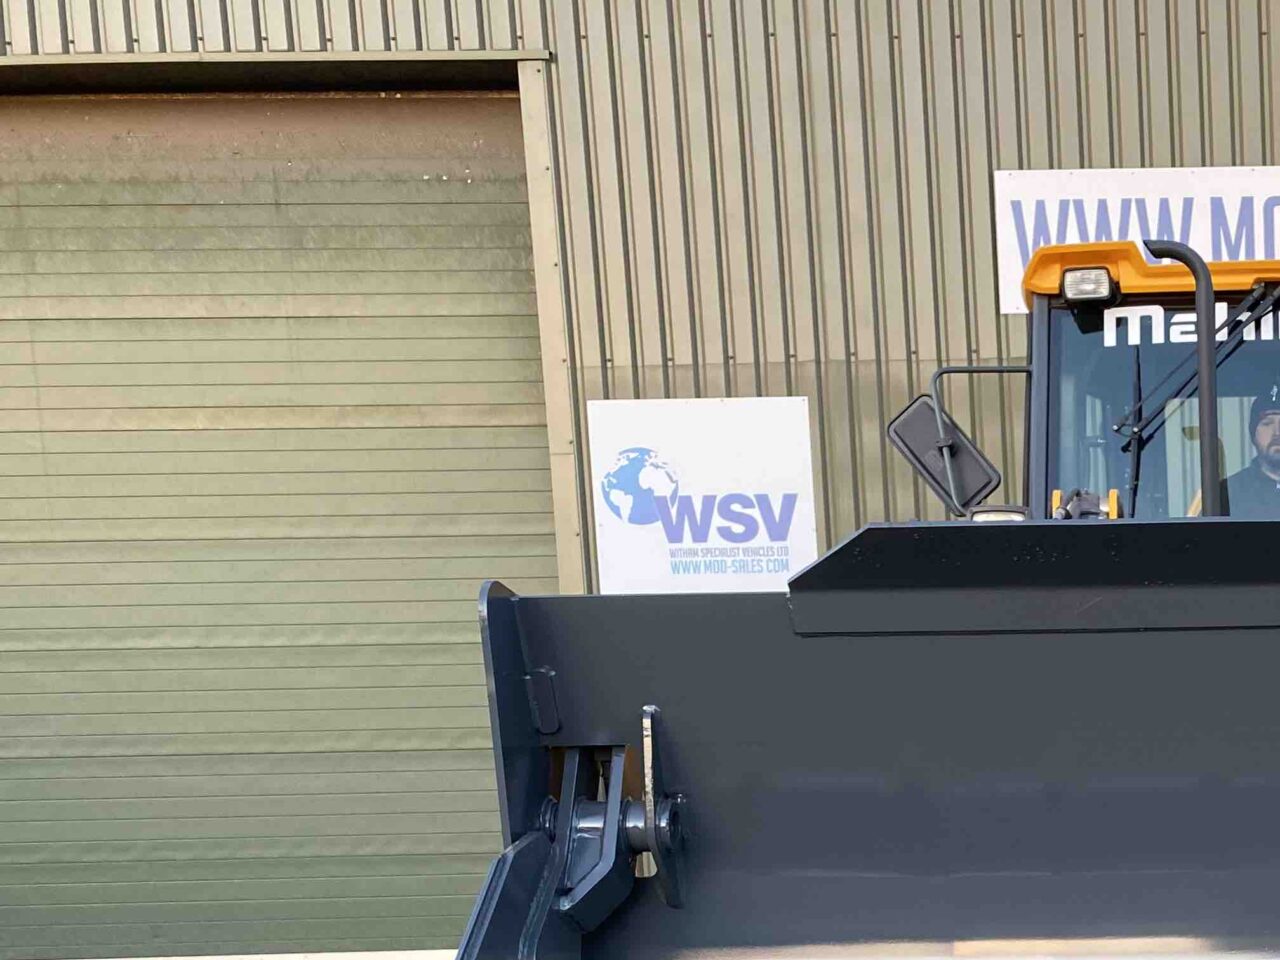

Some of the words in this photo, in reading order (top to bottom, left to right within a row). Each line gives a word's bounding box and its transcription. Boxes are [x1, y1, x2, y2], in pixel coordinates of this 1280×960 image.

[653, 493, 798, 543] WSV
[700, 547, 740, 558] SPECIALIST
[742, 546, 775, 557] VEHICLES
[776, 546, 789, 556] LTD
